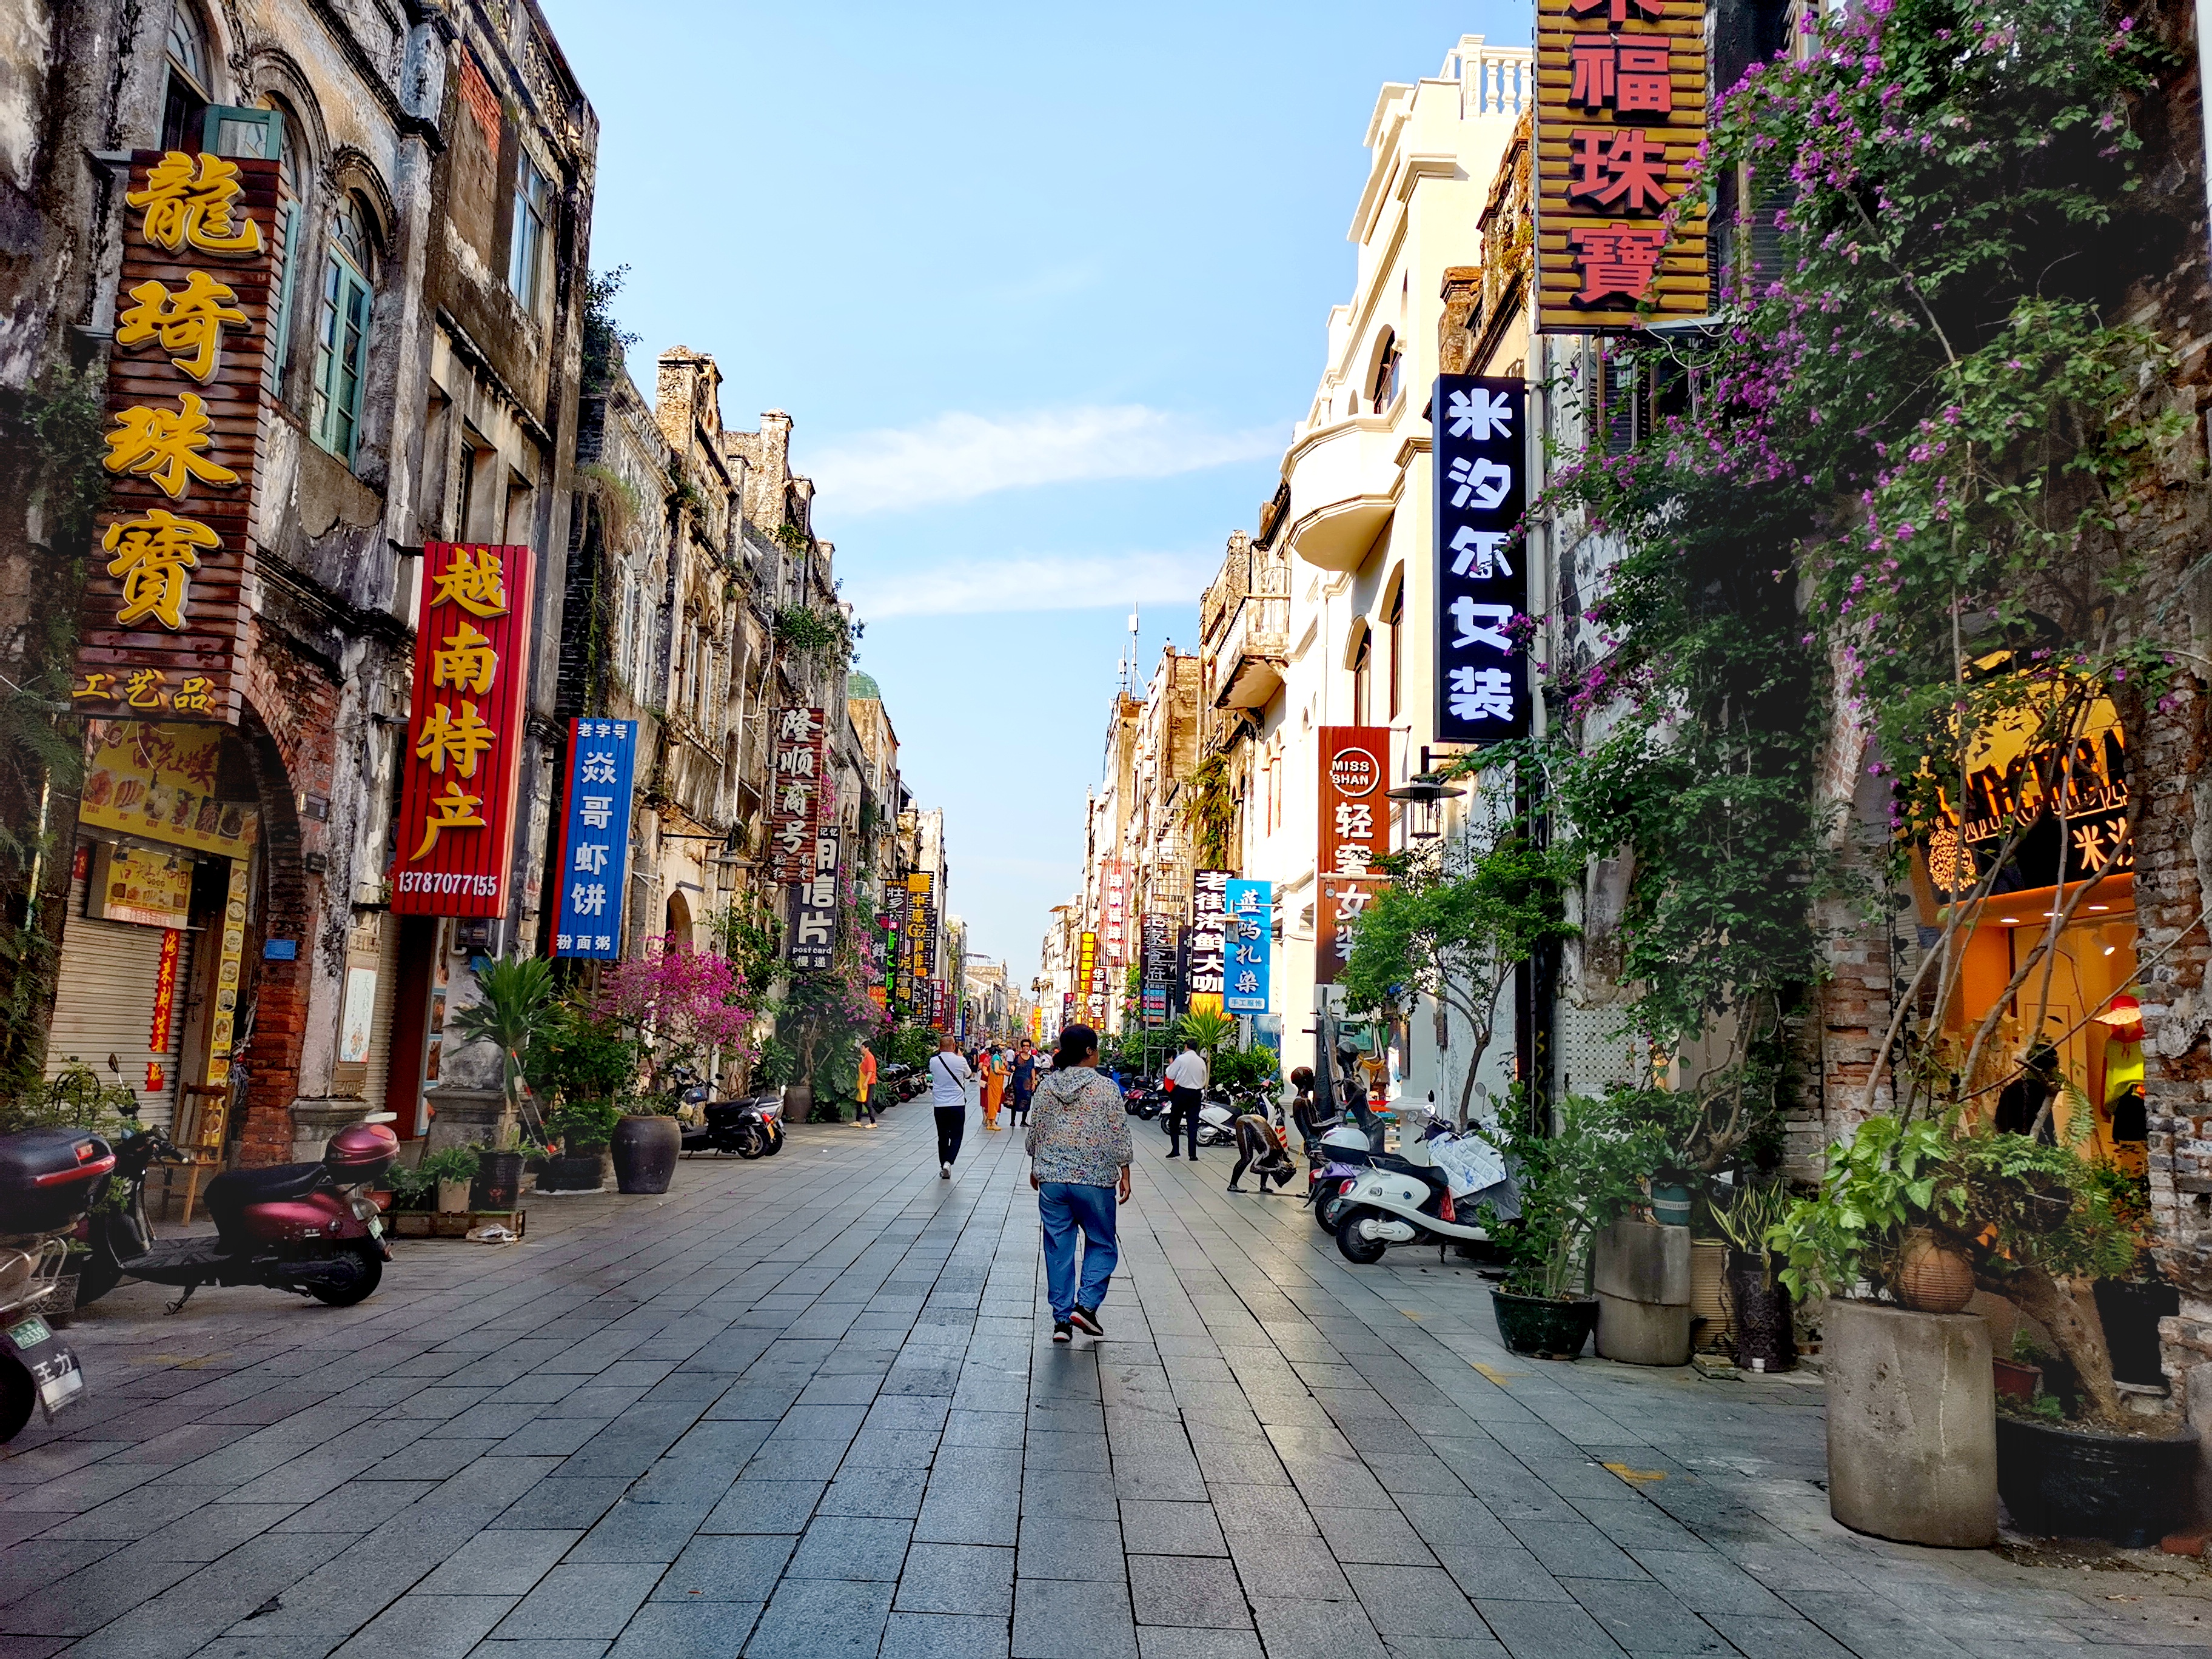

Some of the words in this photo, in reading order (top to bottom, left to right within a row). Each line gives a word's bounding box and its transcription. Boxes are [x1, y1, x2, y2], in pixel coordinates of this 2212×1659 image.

[104, 151, 267, 630] 龍琦珠寶
[1449, 388, 1513, 722] 米汐尔女装
[72, 669, 216, 715] 工艺品
[409, 548, 510, 862] 越南特产
[578, 723, 627, 740] 老字号
[774, 708, 822, 853] 隆顺商号
[1332, 760, 1370, 772] MISS
[1332, 774, 1369, 786] SHAN
[571, 751, 617, 916] 焱哥虾饼
[820, 828, 838, 837] 记忆
[398, 871, 497, 896] 13787077155
[557, 933, 611, 951] 粉面粥
[32, 1353, 72, 1386] 王力
